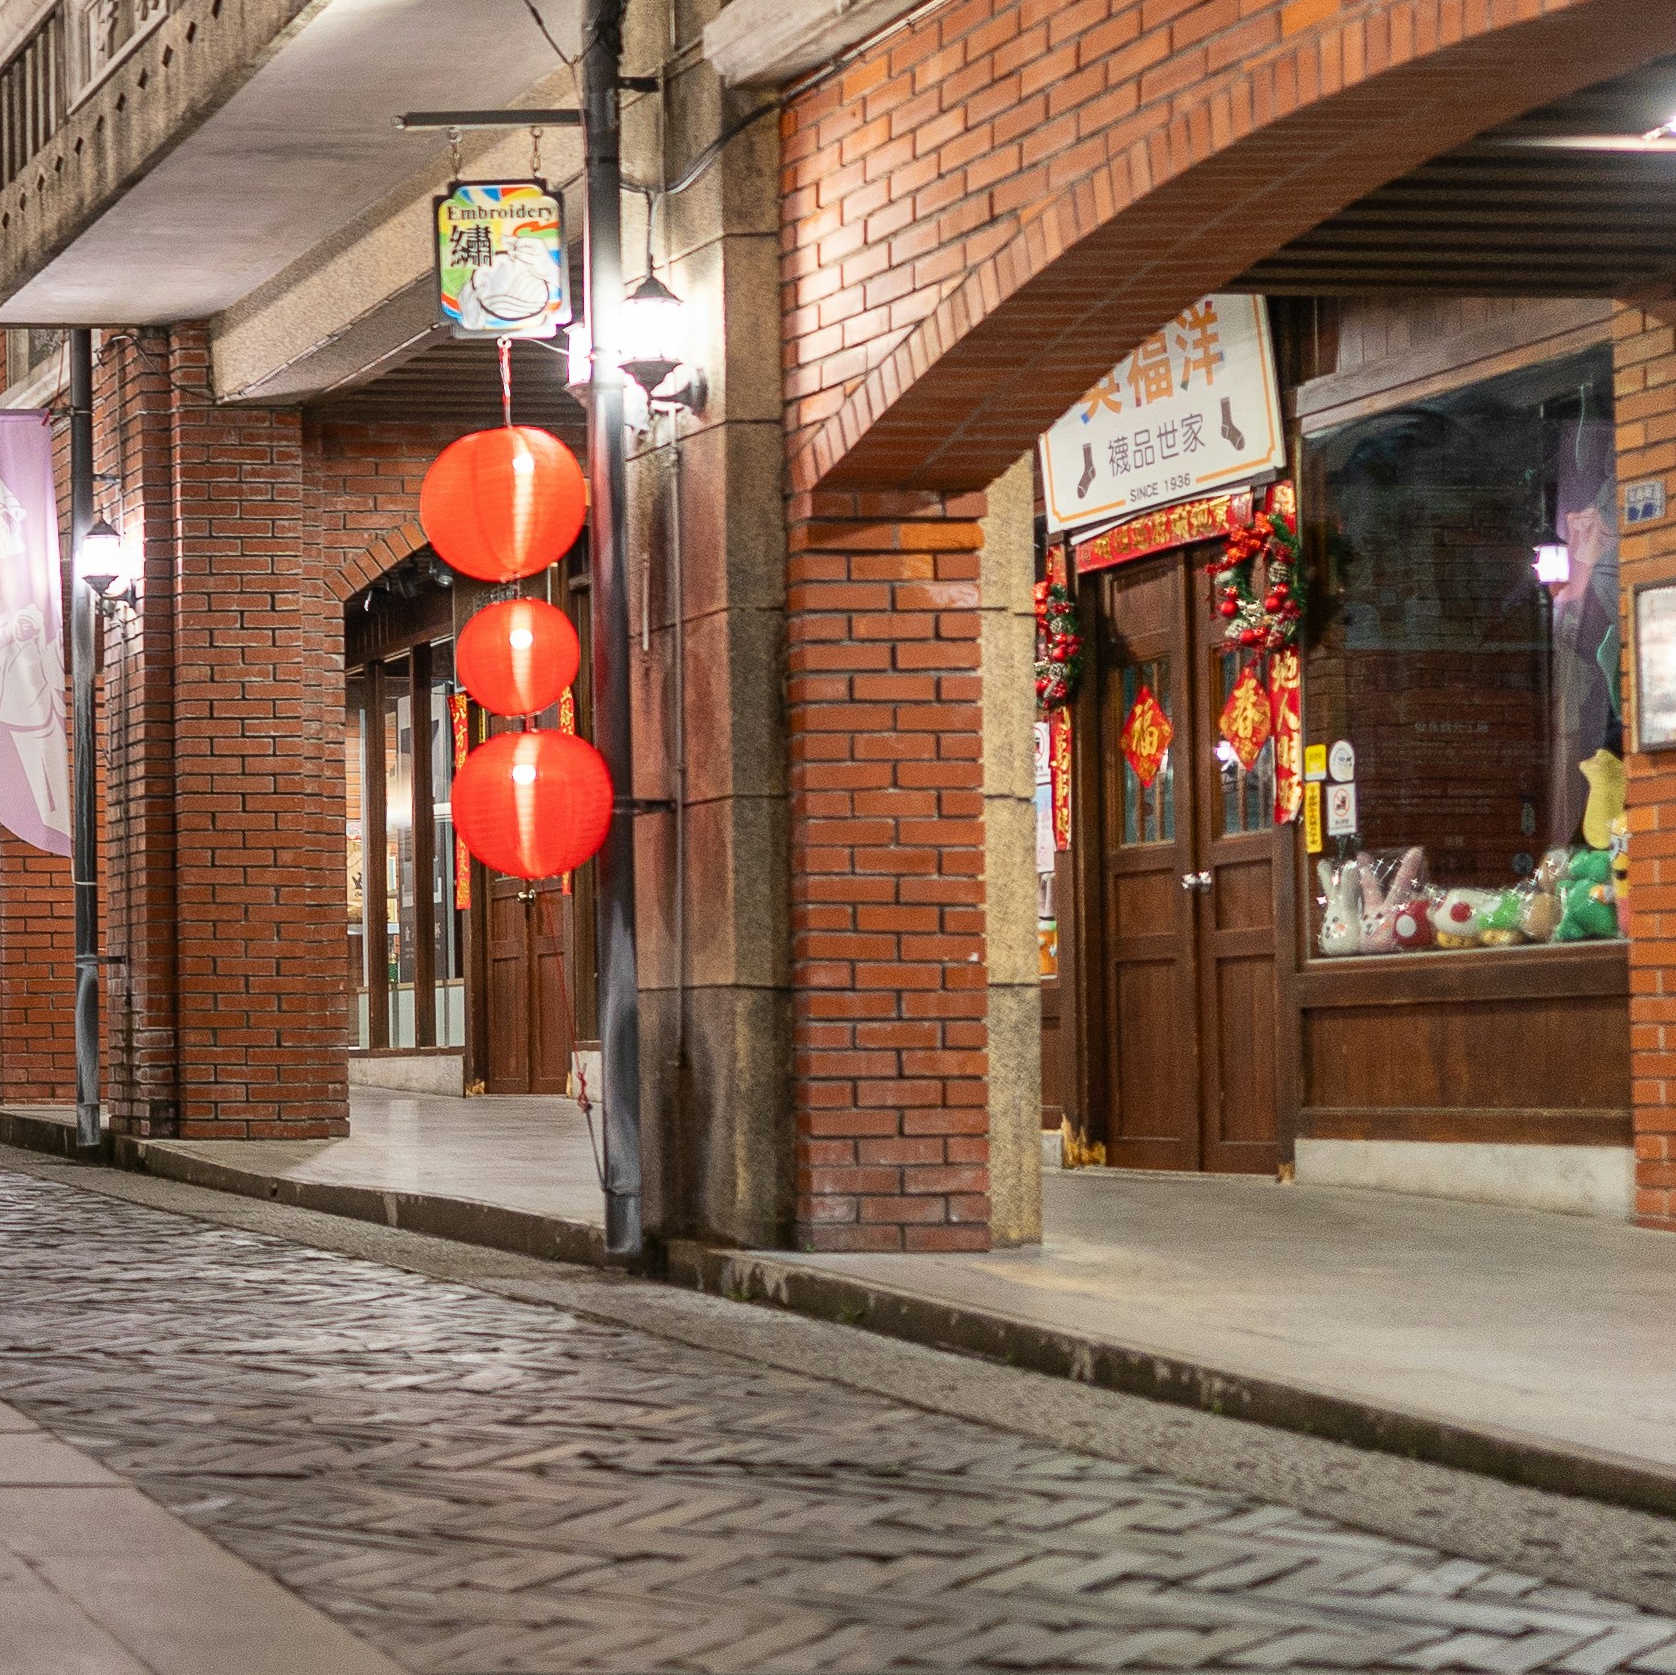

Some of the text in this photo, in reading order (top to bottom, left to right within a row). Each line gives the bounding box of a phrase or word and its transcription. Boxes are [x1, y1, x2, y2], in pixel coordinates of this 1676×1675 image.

[447, 204, 552, 221] Embroidery
[450, 225, 492, 267] 繡
[1107, 413, 1206, 476] 襪品世家
[1130, 473, 1191, 502] SINCE 1936
[1131, 698, 1159, 757] 福
[1232, 678, 1264, 738] 春
